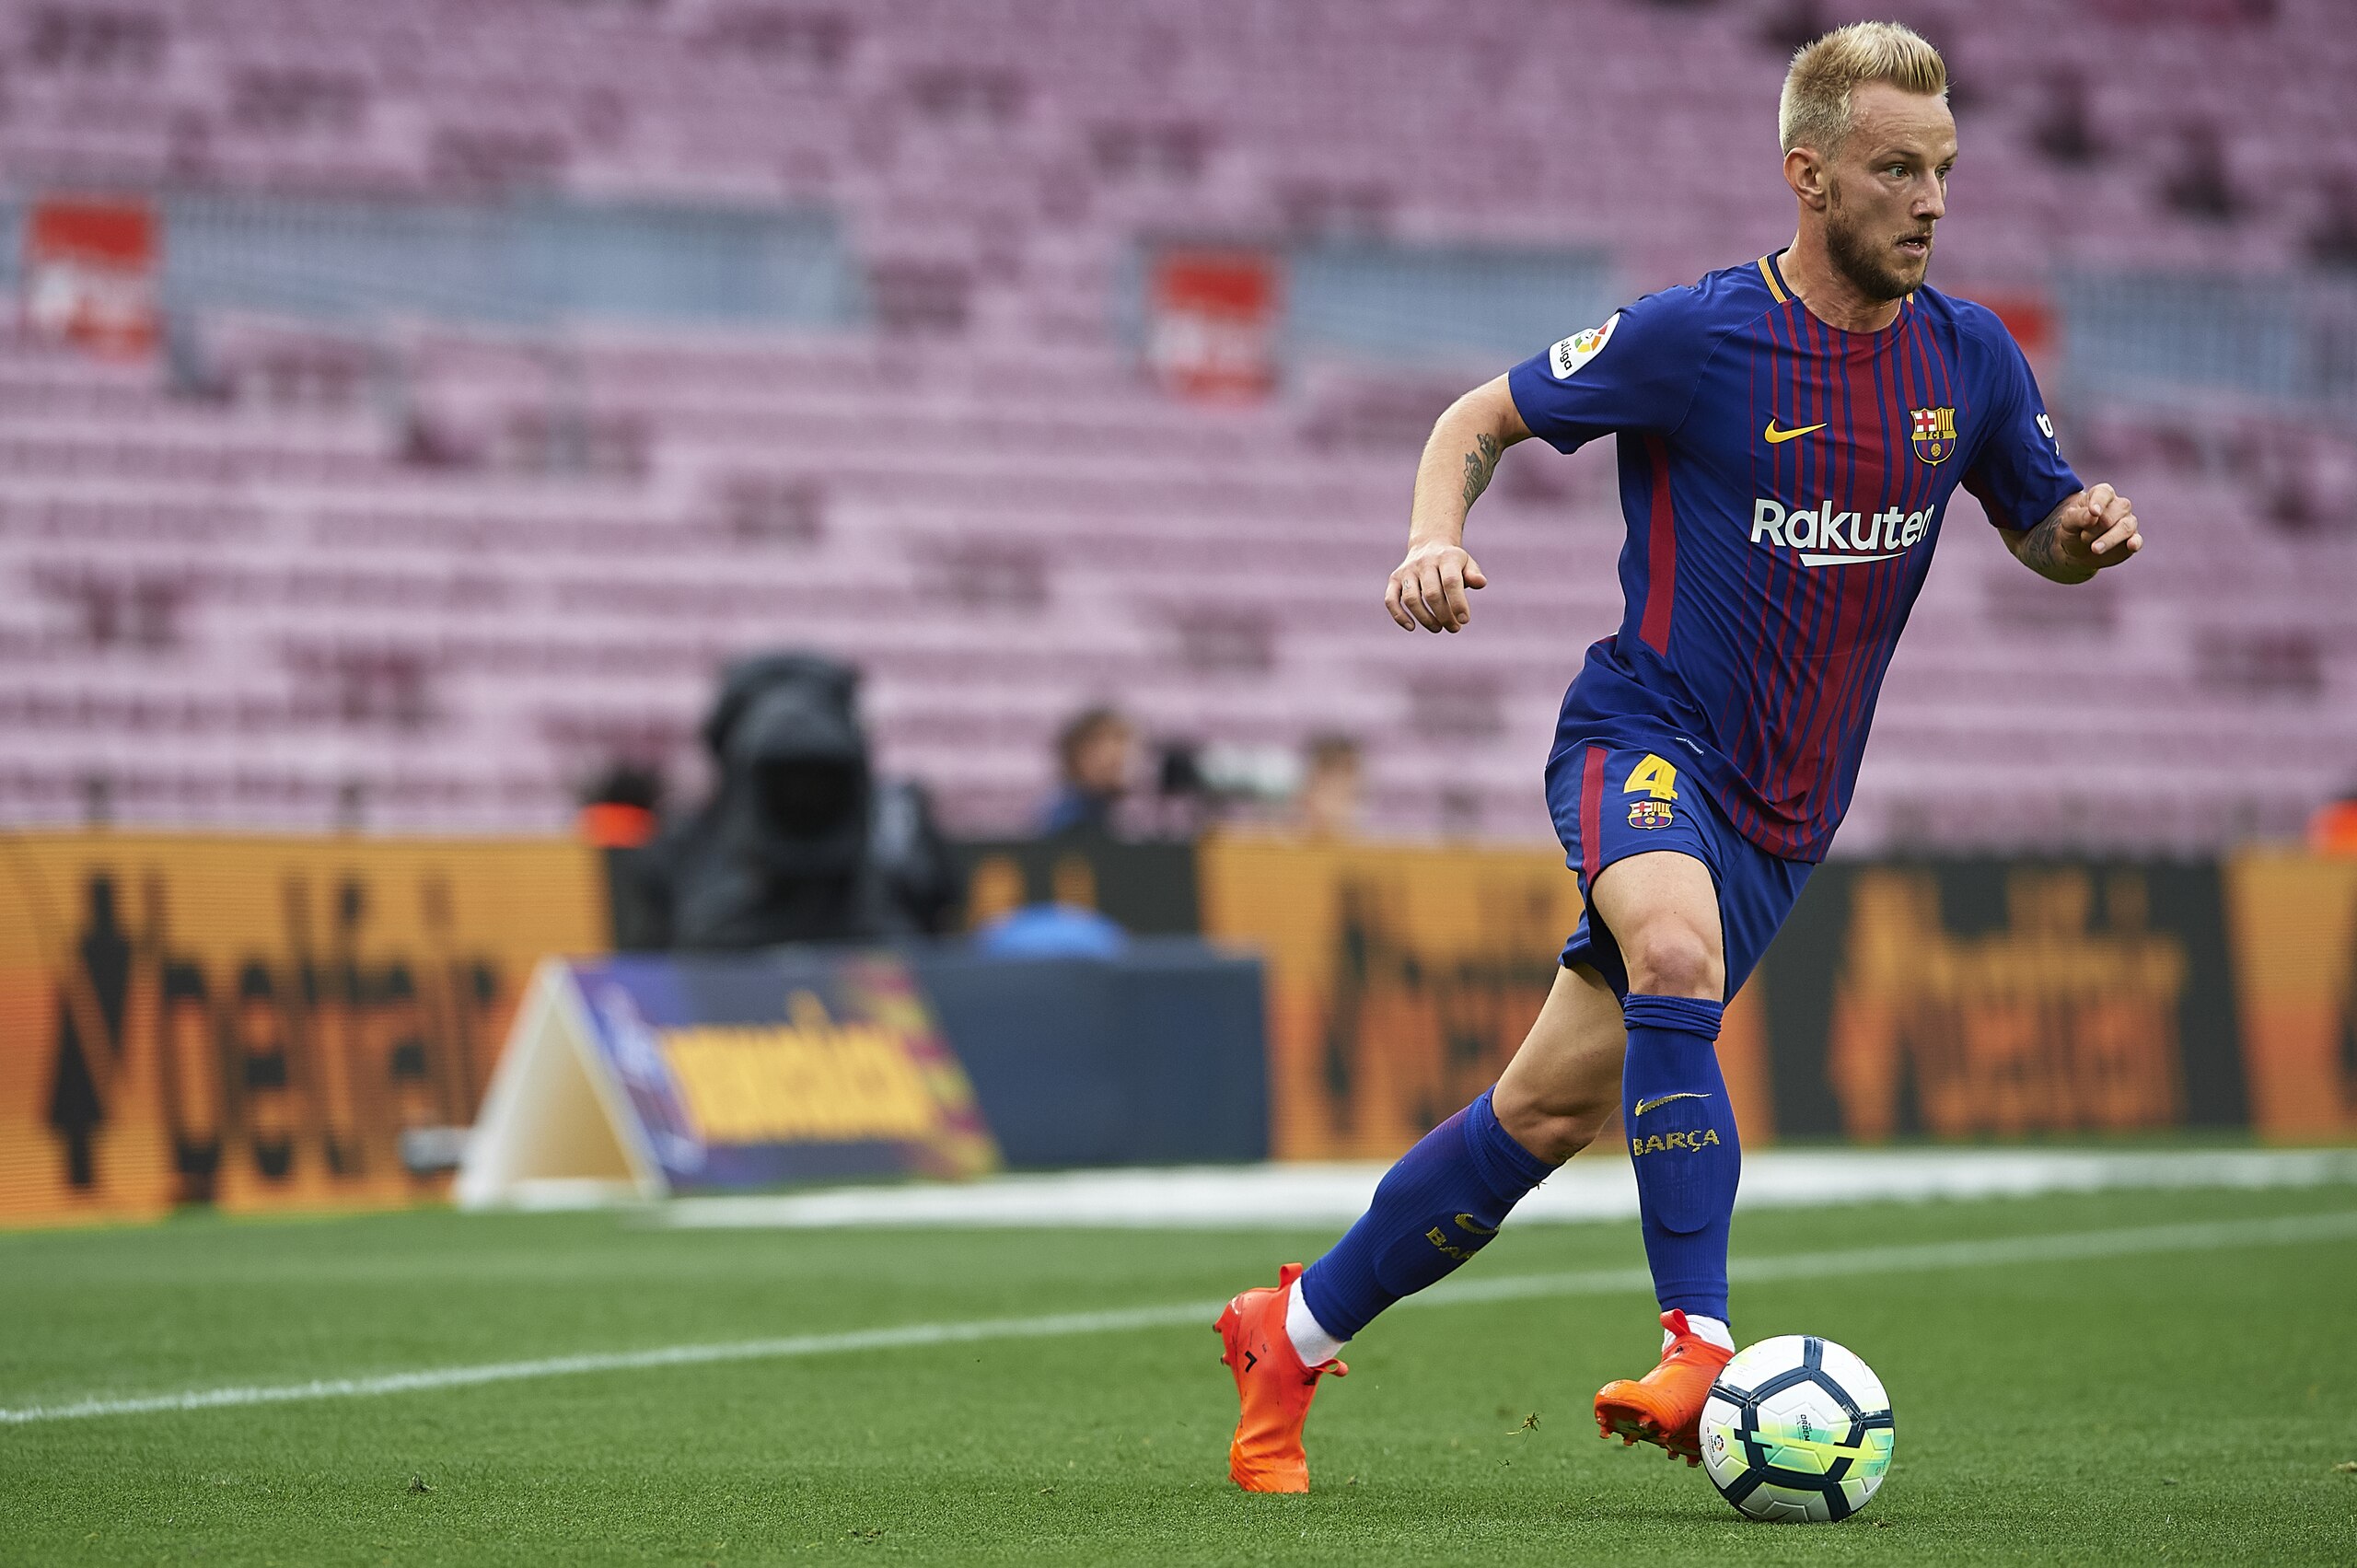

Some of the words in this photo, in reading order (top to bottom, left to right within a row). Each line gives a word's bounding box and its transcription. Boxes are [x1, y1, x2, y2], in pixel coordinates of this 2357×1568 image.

[1925, 431, 1945, 439] FCB
[1750, 498, 1935, 551] Rakuten
[1623, 753, 1678, 801] 4
[1632, 1128, 1720, 1156] BARÇA
